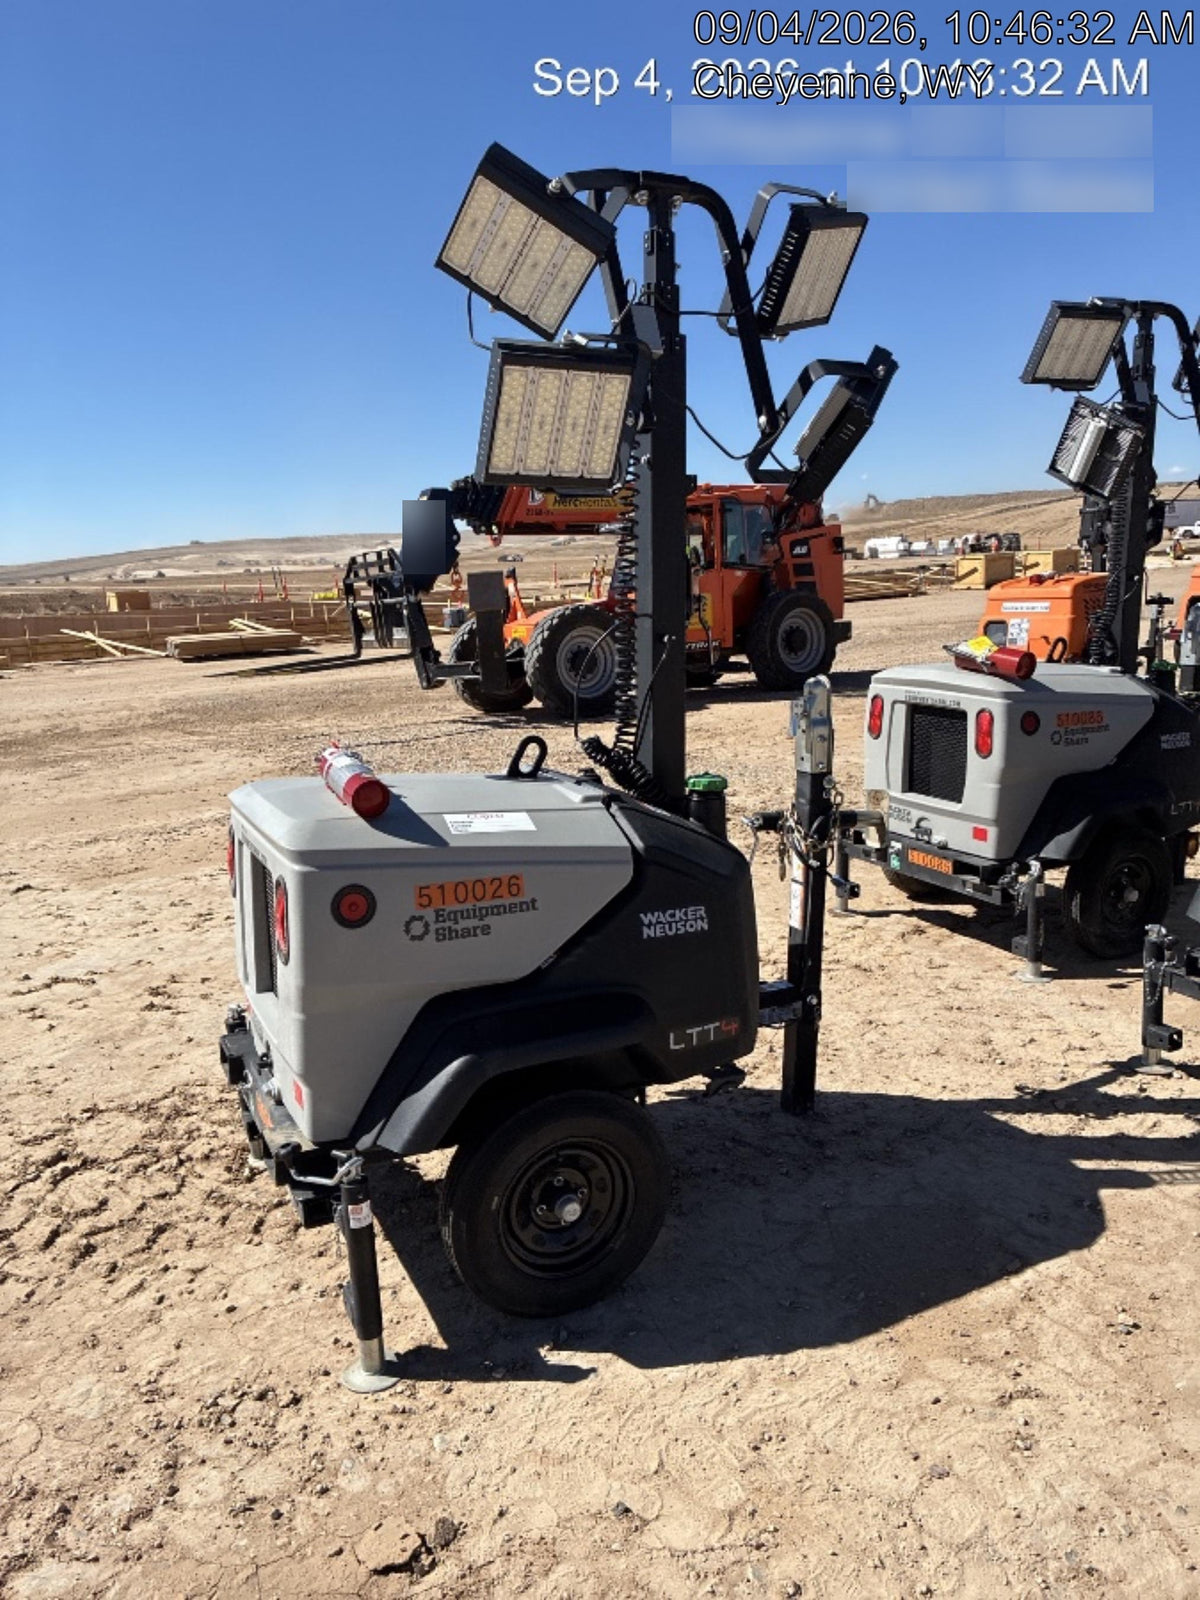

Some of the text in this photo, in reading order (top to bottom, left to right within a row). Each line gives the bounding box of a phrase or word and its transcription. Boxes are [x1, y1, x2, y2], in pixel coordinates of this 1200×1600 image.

[418, 874, 521, 908] 510026
[433, 897, 539, 925] Equipment
[640, 906, 707, 925] WACKER
[434, 923, 491, 943] Share
[642, 918, 709, 939] NEUSON
[669, 1016, 739, 1050] LTT4
